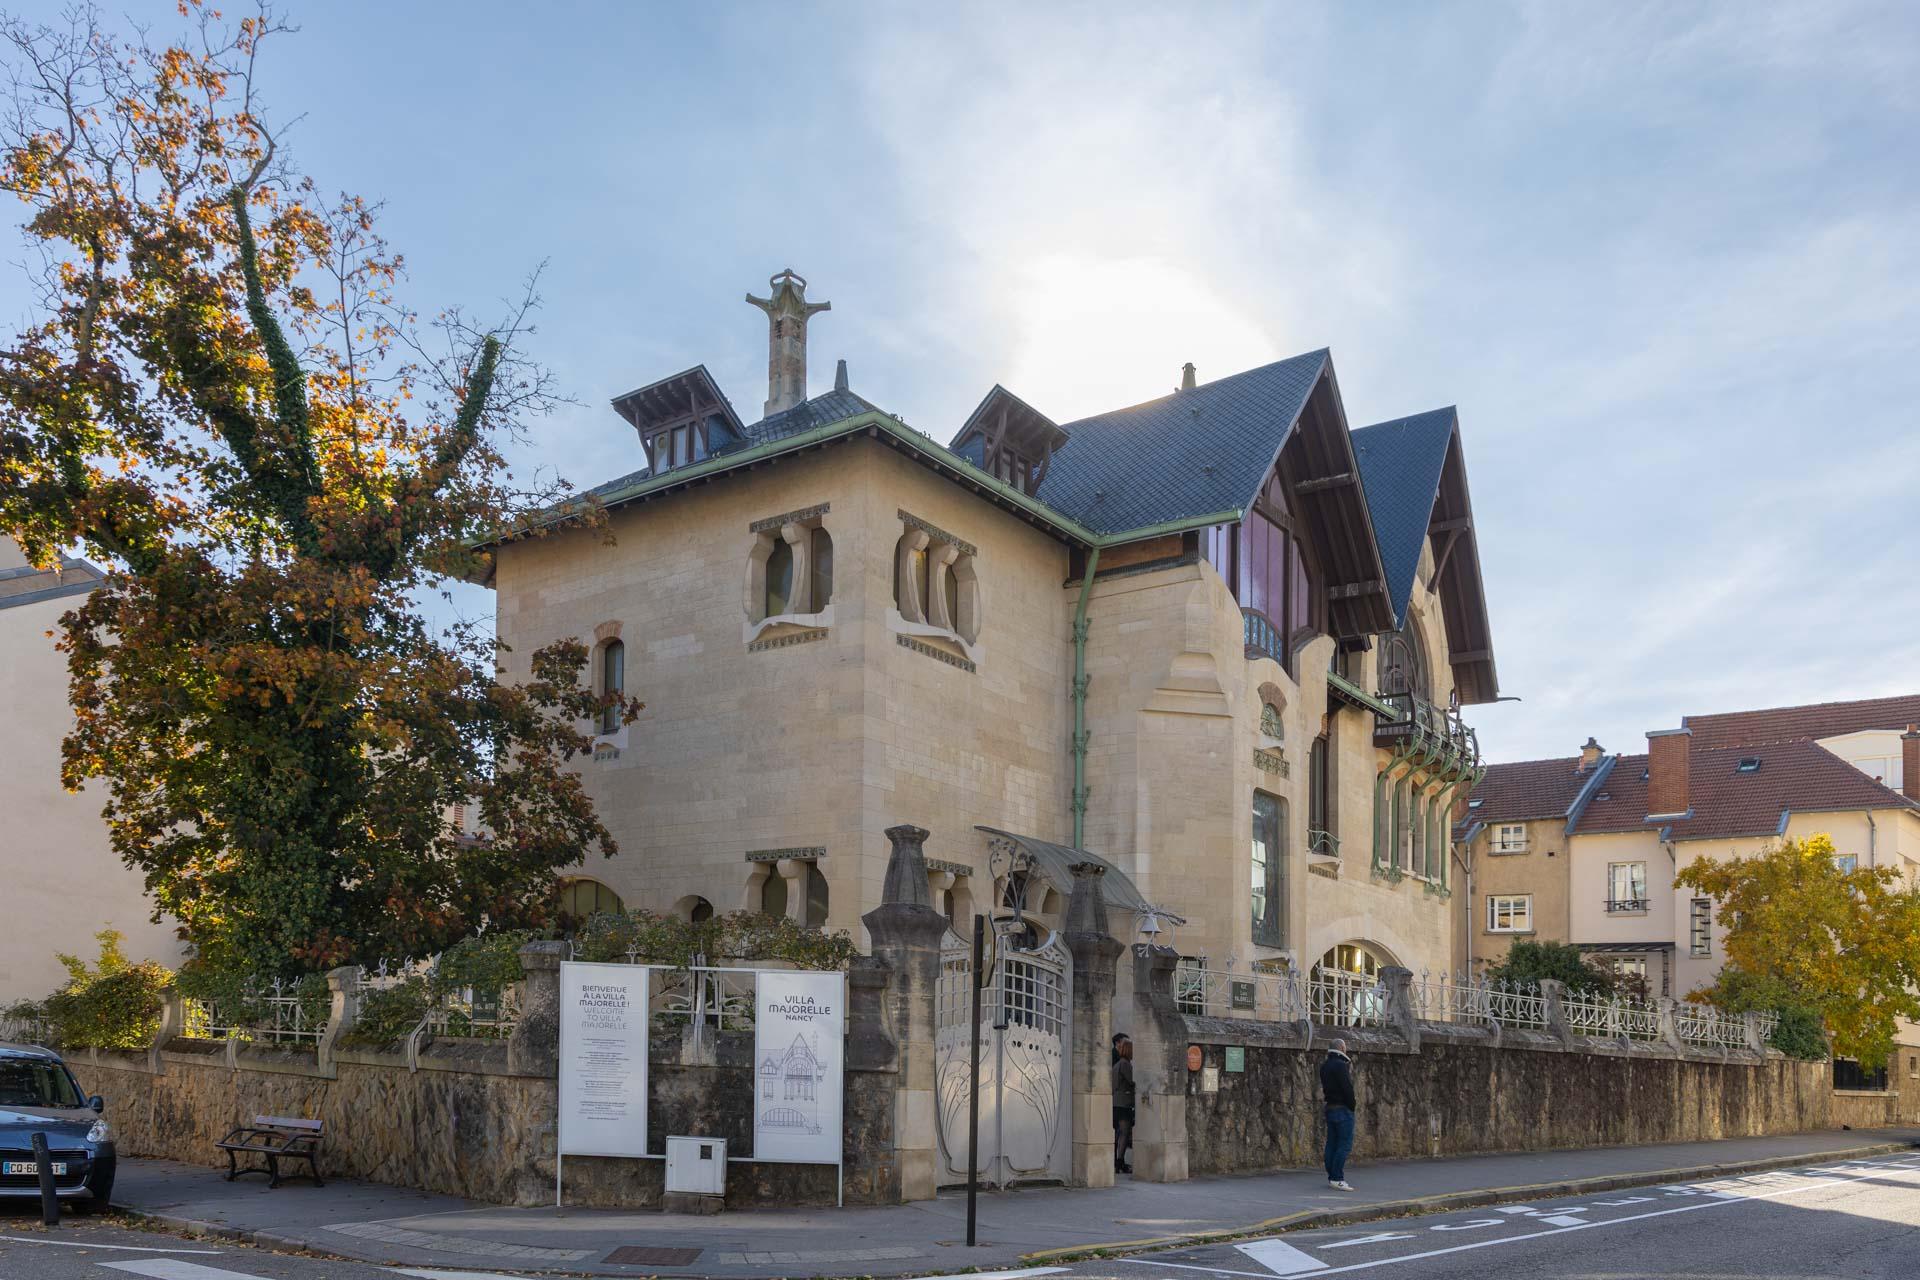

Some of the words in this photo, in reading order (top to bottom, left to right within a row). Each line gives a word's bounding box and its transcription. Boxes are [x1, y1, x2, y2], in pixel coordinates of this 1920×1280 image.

[582, 985, 627, 993] BIENVENUE
[784, 995, 815, 1004] VILLA
[768, 1004, 831, 1015] MAJORELLE
[785, 1014, 814, 1022] NANCY
[581, 1021, 627, 1029] MAJORELLE
